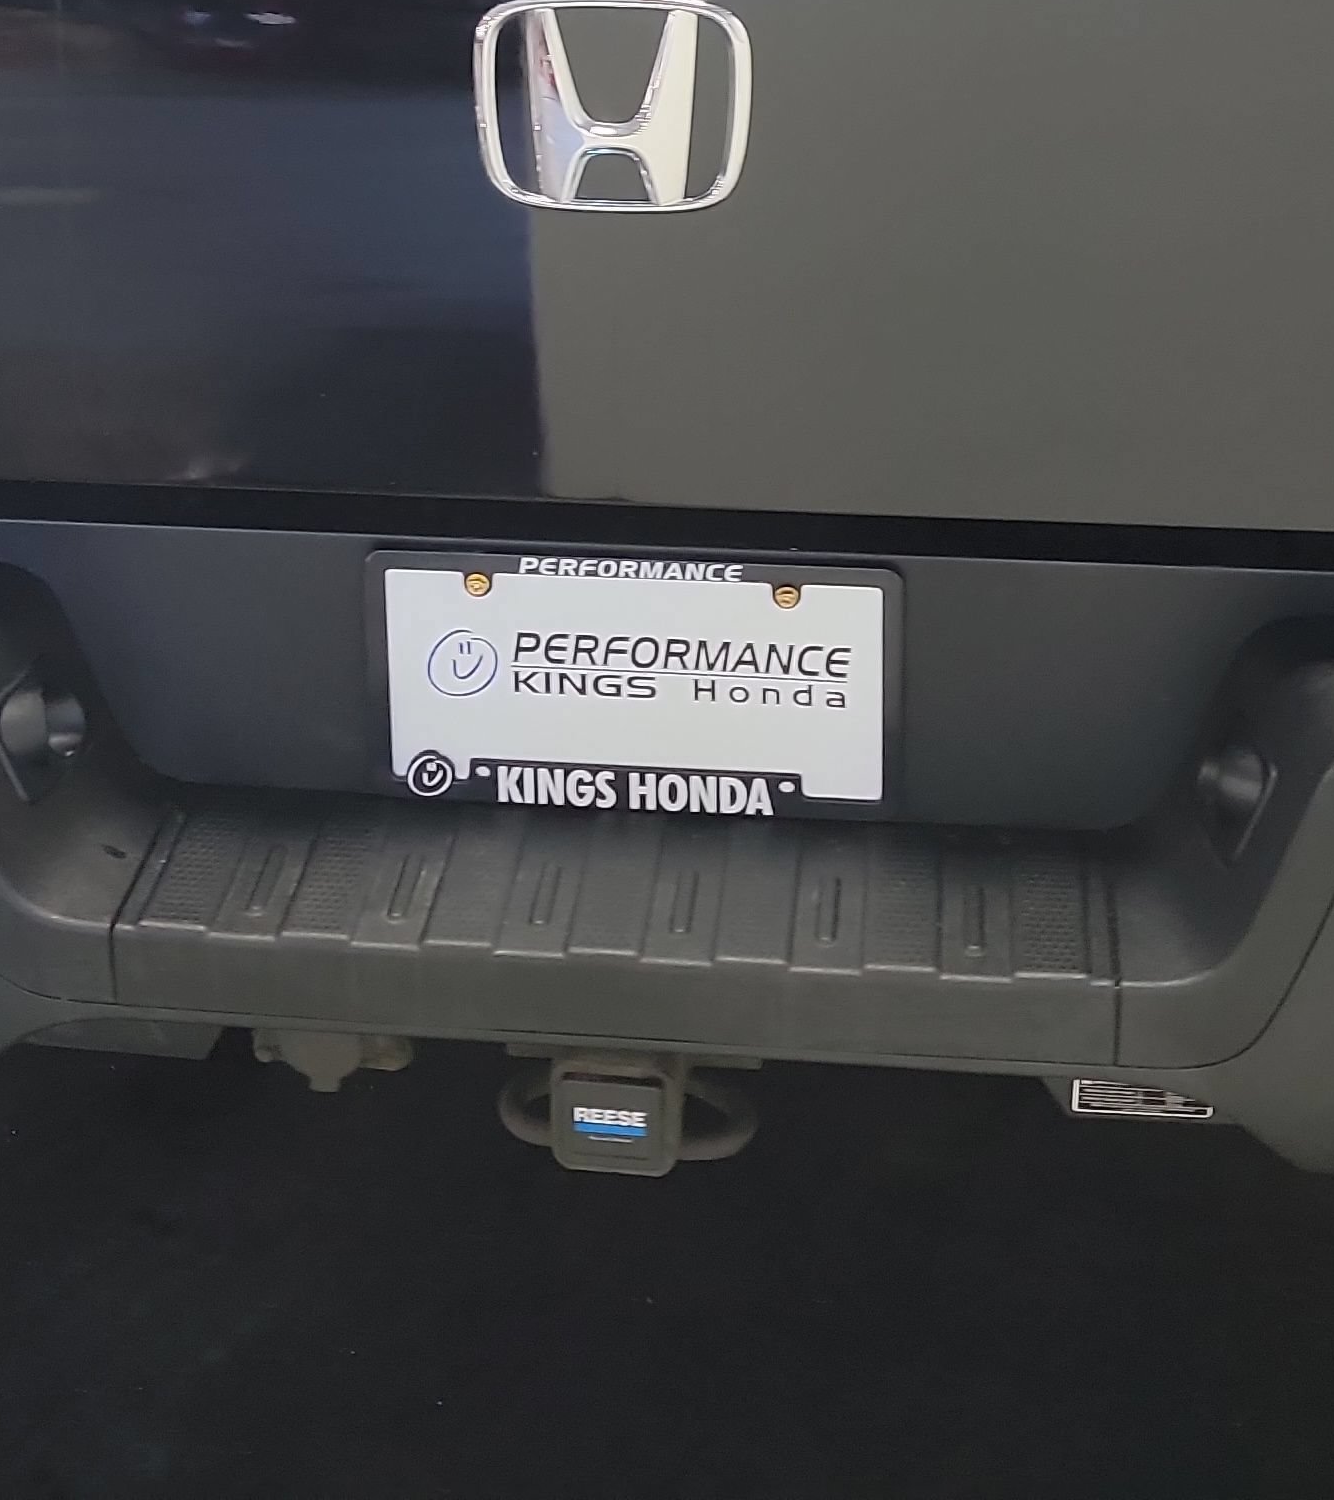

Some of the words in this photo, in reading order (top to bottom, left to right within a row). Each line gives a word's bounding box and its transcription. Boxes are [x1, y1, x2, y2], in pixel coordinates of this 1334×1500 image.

[519, 557, 744, 582] PERFORMANCE
[514, 631, 852, 677] PERFORMANCE
[514, 670, 658, 699] KINGS
[693, 679, 847, 708] Honda
[497, 766, 619, 809] KINGS
[627, 772, 774, 815] HONDA
[573, 1106, 648, 1128] REESE
